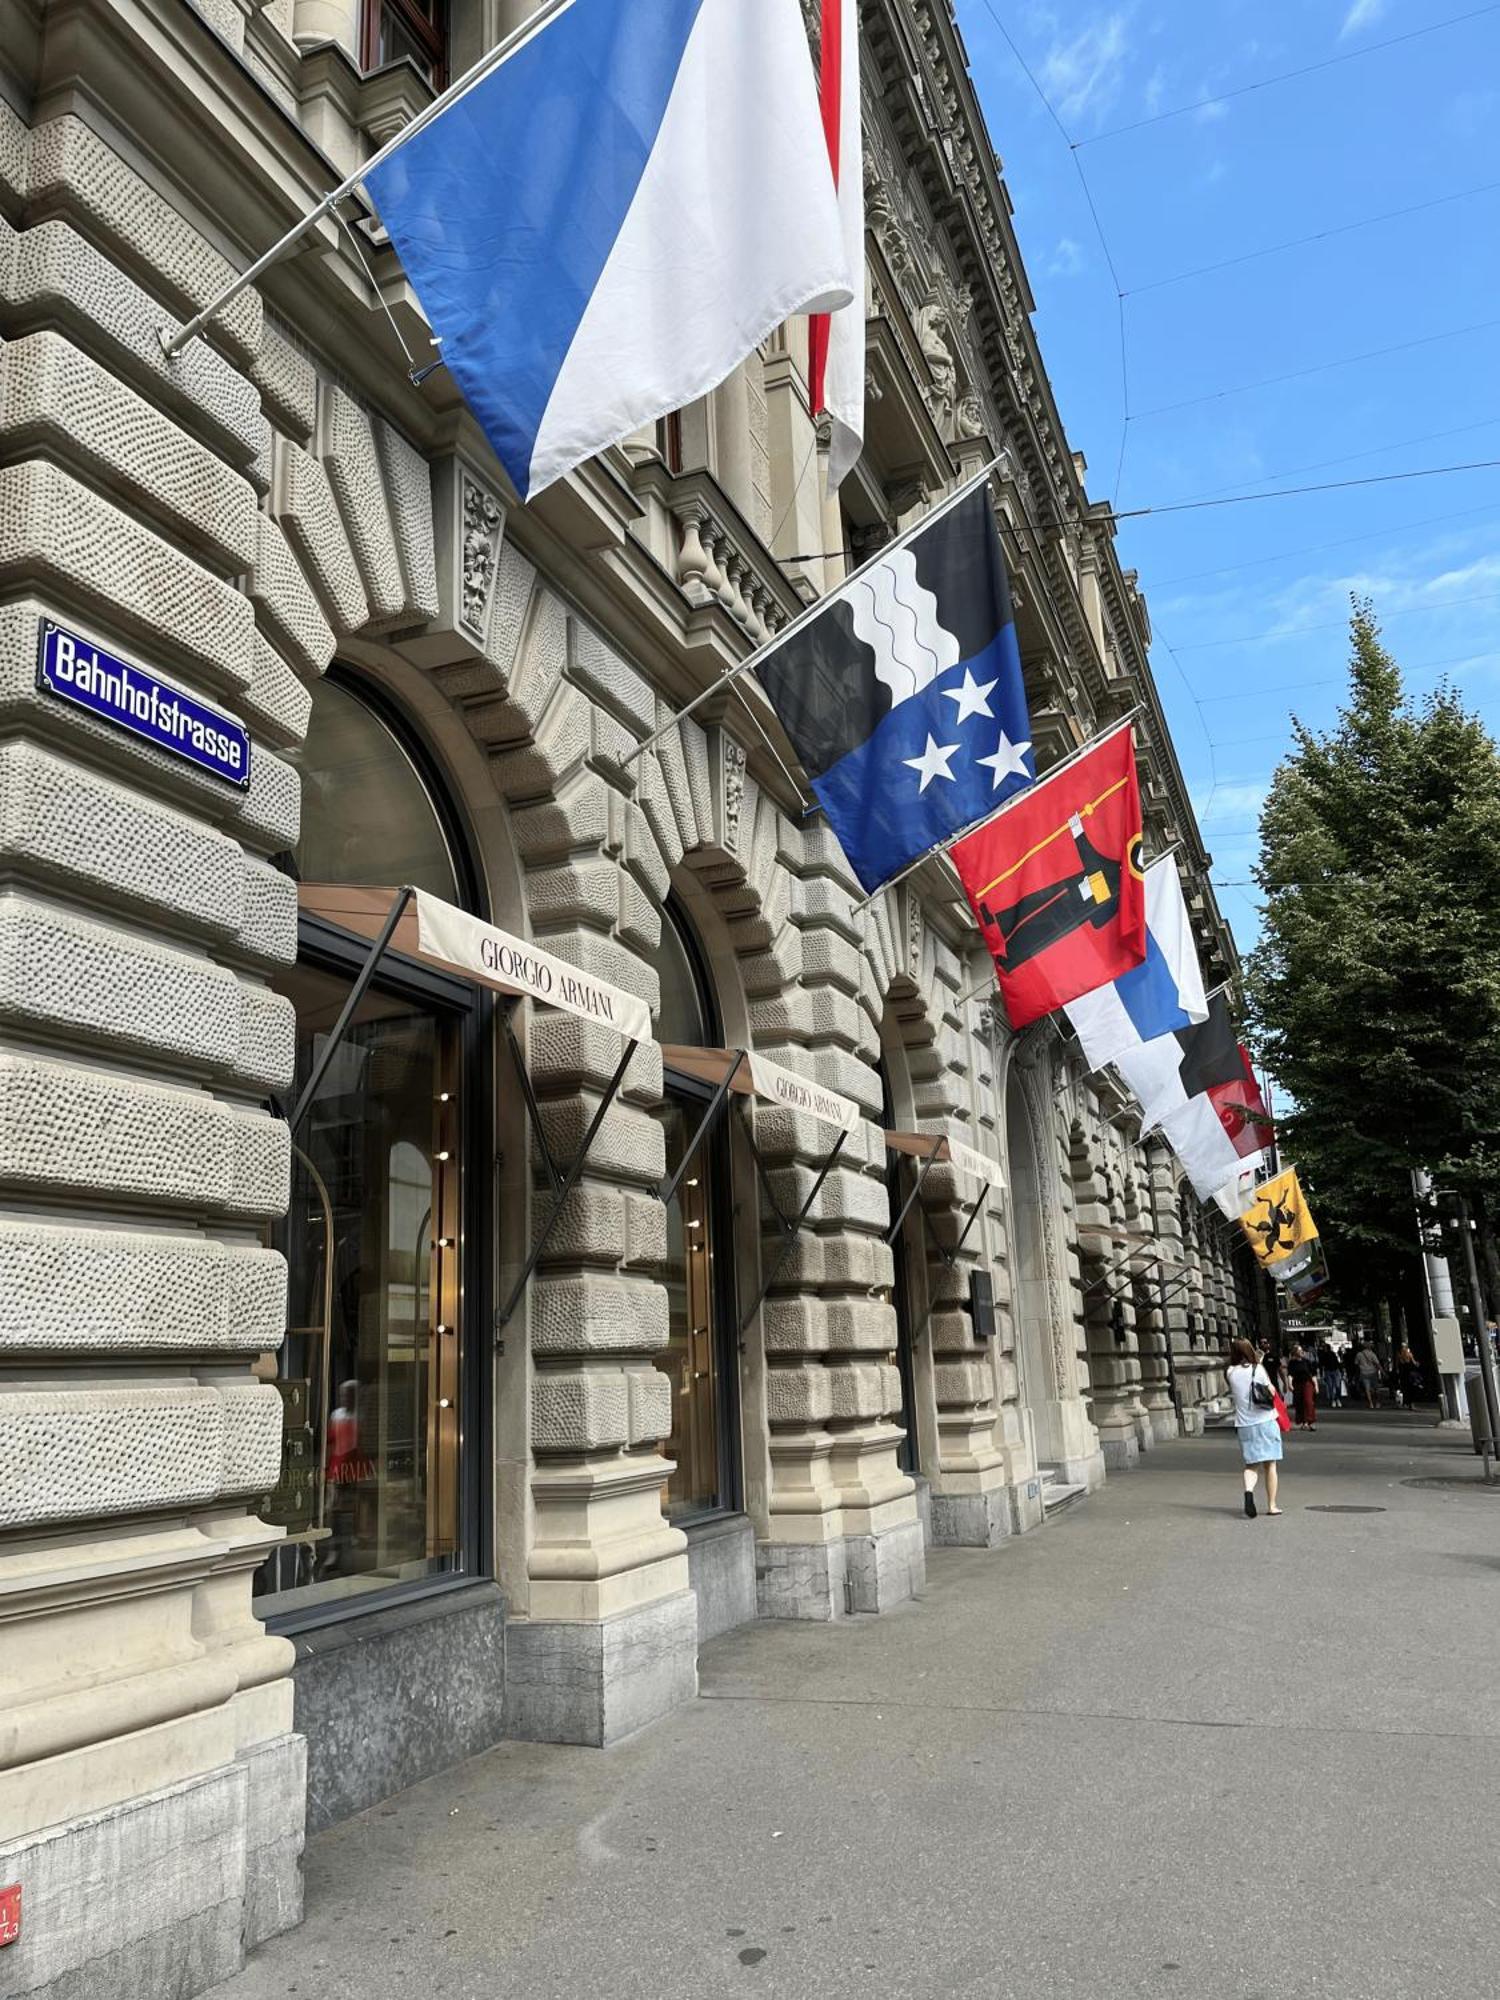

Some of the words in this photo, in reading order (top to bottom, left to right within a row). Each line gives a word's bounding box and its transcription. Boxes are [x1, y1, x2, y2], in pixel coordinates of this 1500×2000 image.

[56, 633, 242, 769] Bahnhofstrasse
[480, 937, 552, 993] GIORGIO
[559, 975, 613, 1021] ARMANI
